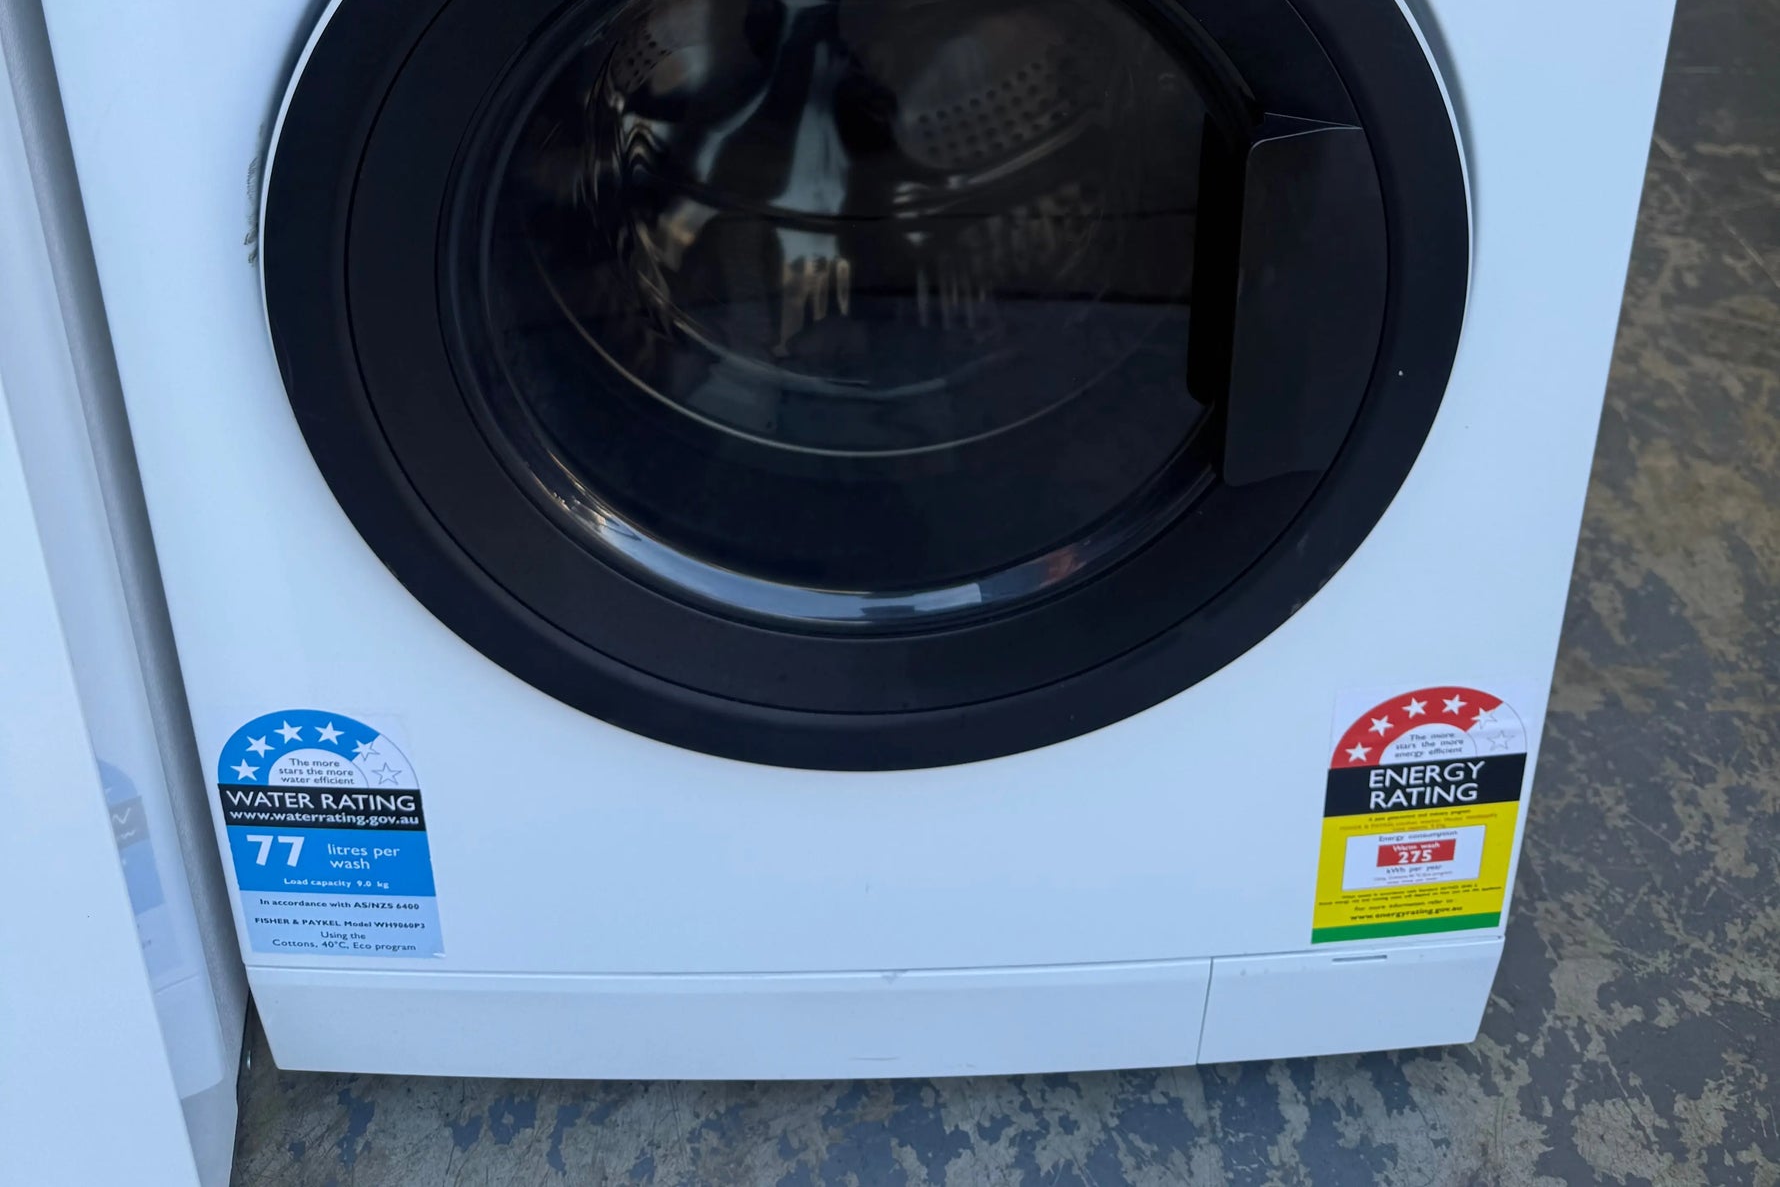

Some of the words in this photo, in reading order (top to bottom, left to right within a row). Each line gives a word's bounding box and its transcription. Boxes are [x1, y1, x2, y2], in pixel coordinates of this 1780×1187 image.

[1429, 747, 1462, 755] efficient
[289, 758, 310, 766] The
[279, 767, 303, 775] stars
[307, 767, 323, 775] the
[1369, 761, 1485, 789] ENERGY
[314, 776, 354, 785] efficient
[226, 791, 314, 808] WATER
[321, 794, 416, 811] RATING
[1370, 783, 1478, 810] RATING
[230, 810, 419, 826] www.waterrating.gov.au
[246, 835, 305, 867] 77
[1420, 841, 1440, 850] wash
[328, 844, 368, 856] litres
[374, 847, 400, 859] per
[1398, 850, 1432, 863] 275
[330, 858, 370, 870] wash
[311, 879, 351, 888] capacity
[377, 881, 389, 889] kg
[320, 931, 348, 940] Using
[375, 944, 416, 952] program
